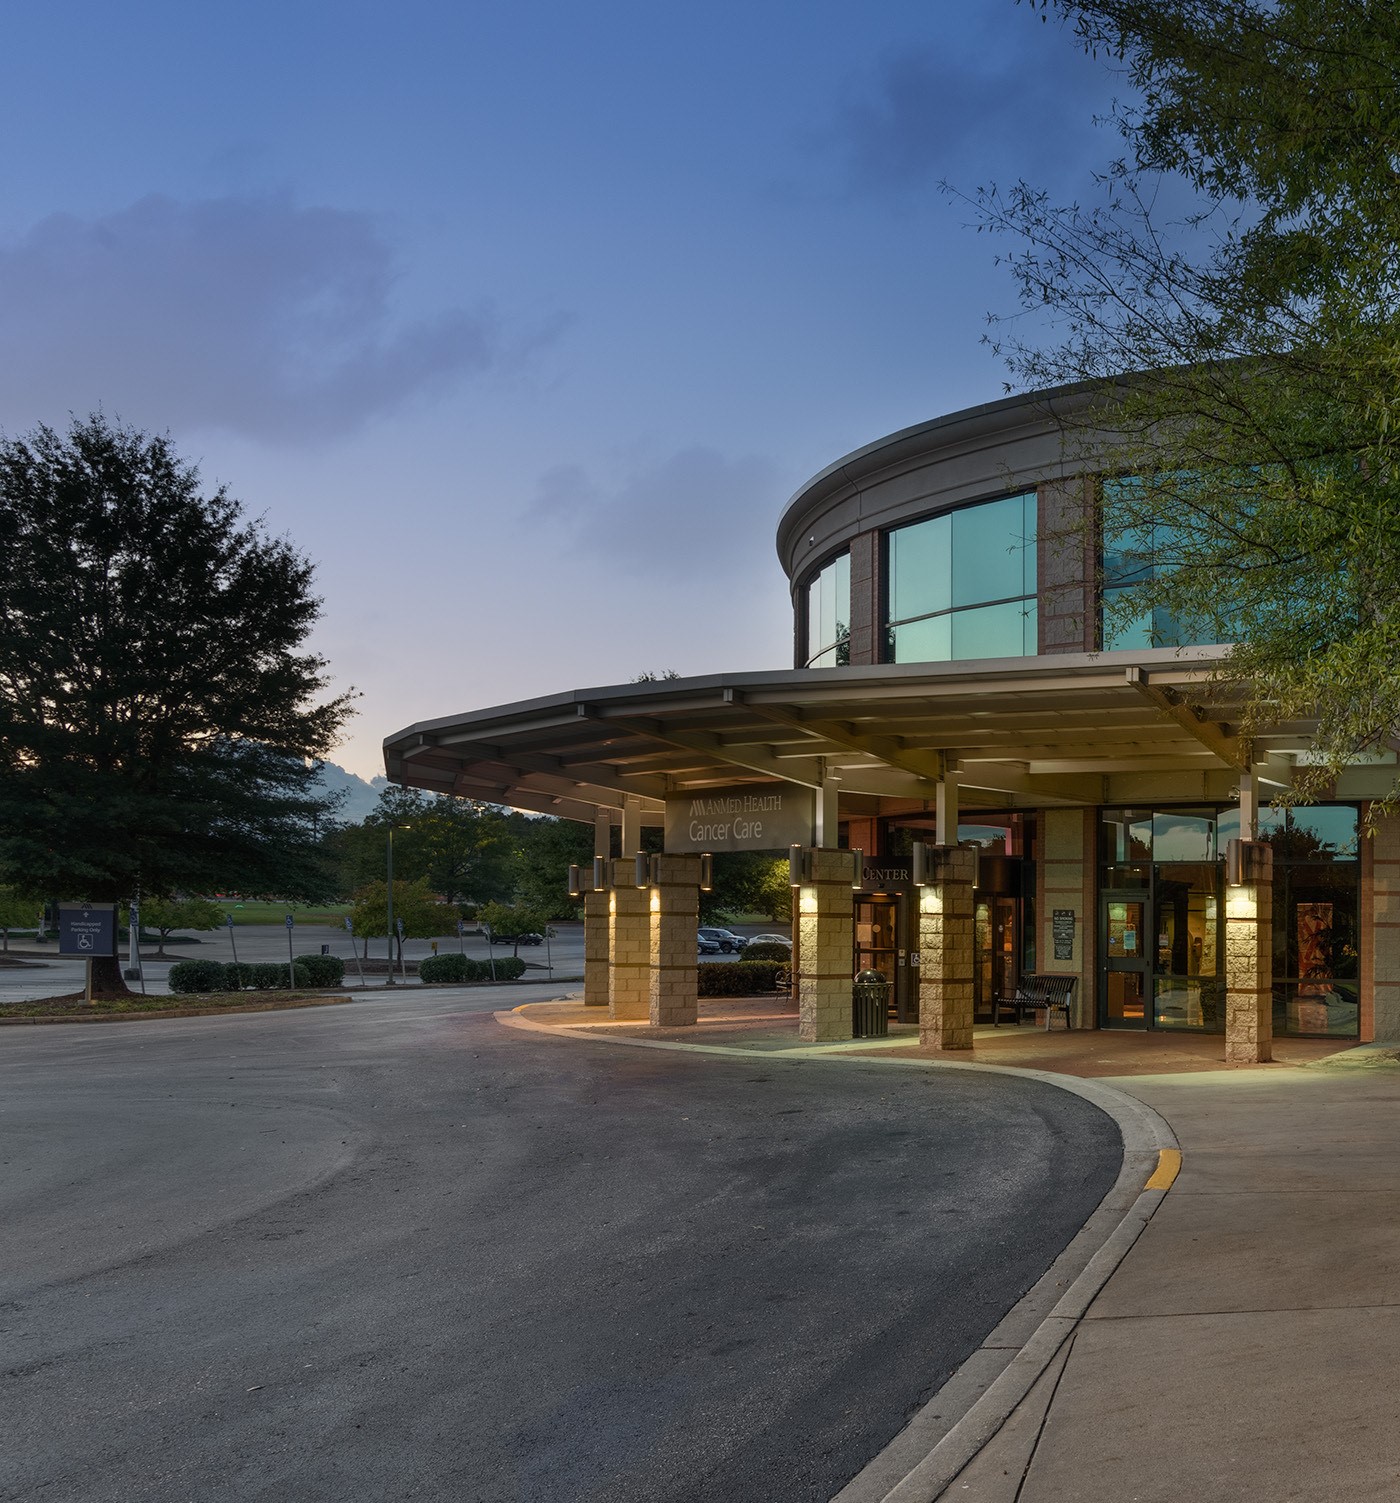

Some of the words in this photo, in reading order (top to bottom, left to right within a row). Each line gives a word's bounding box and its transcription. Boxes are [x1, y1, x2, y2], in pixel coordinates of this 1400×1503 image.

[706, 797, 742, 815] ANMED
[743, 795, 782, 812] HEALTH
[689, 820, 731, 842] Cancer
[733, 817, 762, 839] Care
[862, 866, 909, 880] CENTER
